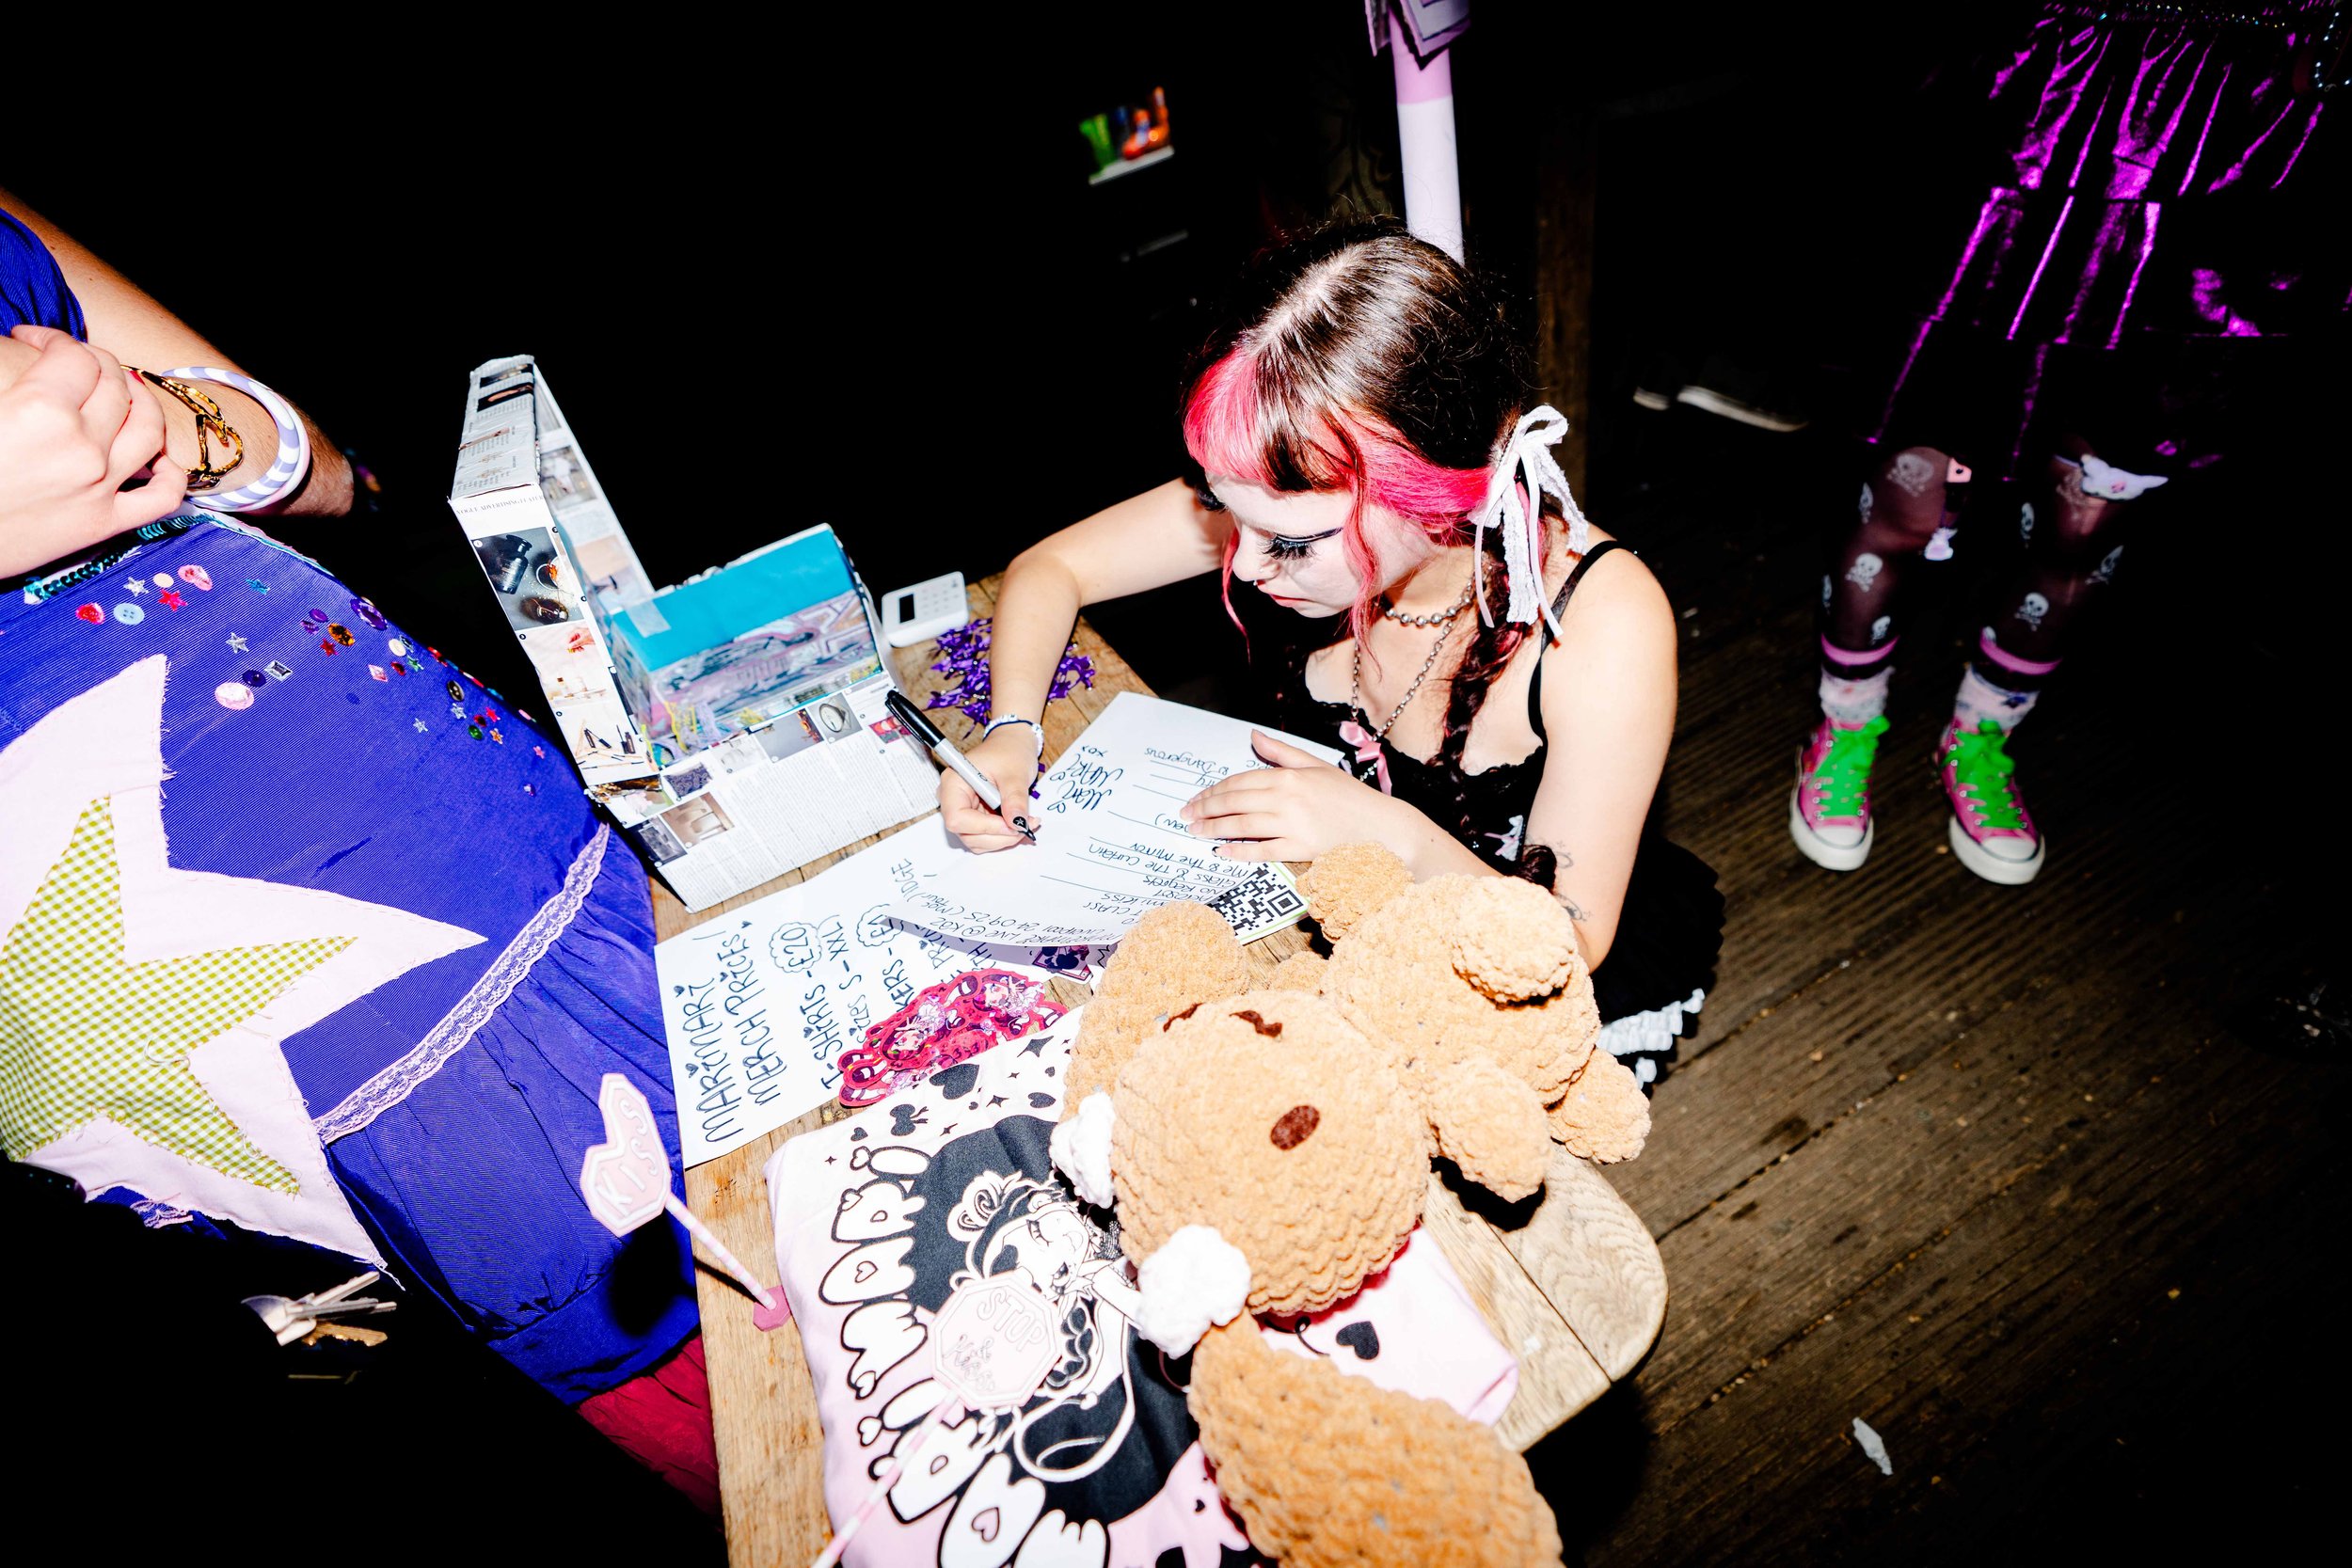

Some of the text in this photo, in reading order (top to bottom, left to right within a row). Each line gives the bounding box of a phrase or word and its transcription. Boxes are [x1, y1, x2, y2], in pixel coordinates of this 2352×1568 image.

[520, 495, 545, 504] FEATUR
[1144, 746, 1216, 773] Dangerous
[1088, 842, 1140, 866] Curtain
[1144, 860, 1170, 875] The
[1178, 854, 1204, 871] The
[780, 927, 815, 968] £20
[882, 958, 914, 1013] KERS
[734, 1008, 787, 1106] MERCH
[595, 1098, 659, 1218] KISS
[977, 1287, 1047, 1353] STOP
